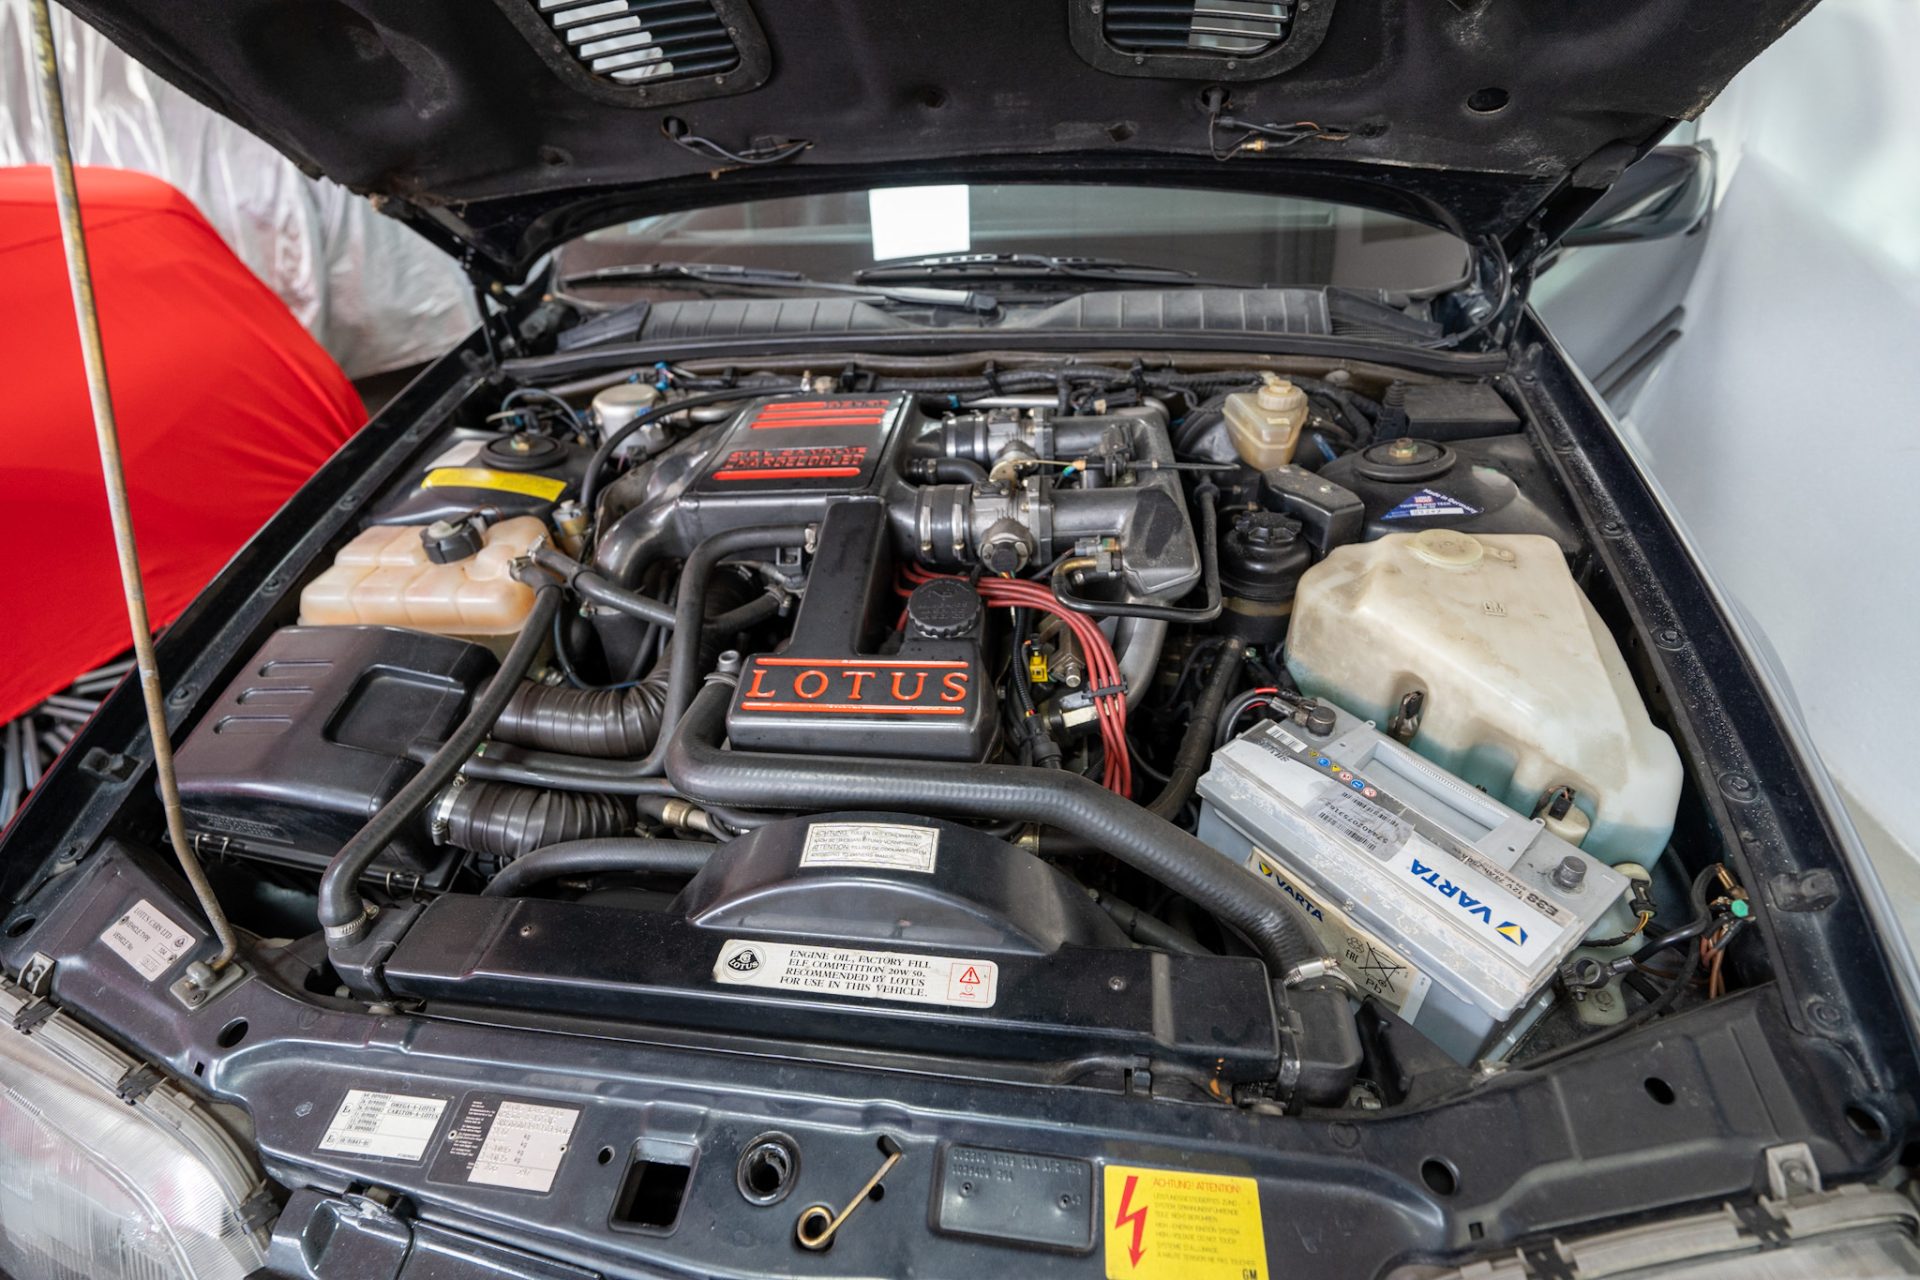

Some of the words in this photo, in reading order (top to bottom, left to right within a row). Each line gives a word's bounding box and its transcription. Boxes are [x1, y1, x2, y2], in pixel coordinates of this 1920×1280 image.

[724, 454, 865, 469] CHARGECOOLED
[745, 669, 969, 702] LOTUS
[1276, 875, 1323, 922] VARTA
[1411, 858, 1492, 925] VARTA
[730, 958, 759, 970] LOTUS
[788, 958, 808, 967] ELF
[812, 960, 885, 974] COMPETITION
[790, 950, 829, 960] ENGINE
[833, 953, 855, 963] OIL,
[858, 955, 904, 967] FACTORY
[908, 959, 931, 969] FILL
[780, 976, 800, 985] FOR
[804, 978, 824, 988] USE
[828, 980, 840, 988] IN
[845, 981, 871, 991] THIS
[876, 984, 928, 997] VEHICLE.
[785, 967, 868, 982] RECOMMENDED
[872, 975, 886, 983] BY
[890, 976, 925, 987] LOTUS
[1365, 977, 1382, 994] Pb
[1242, 1268, 1257, 1280] GM
